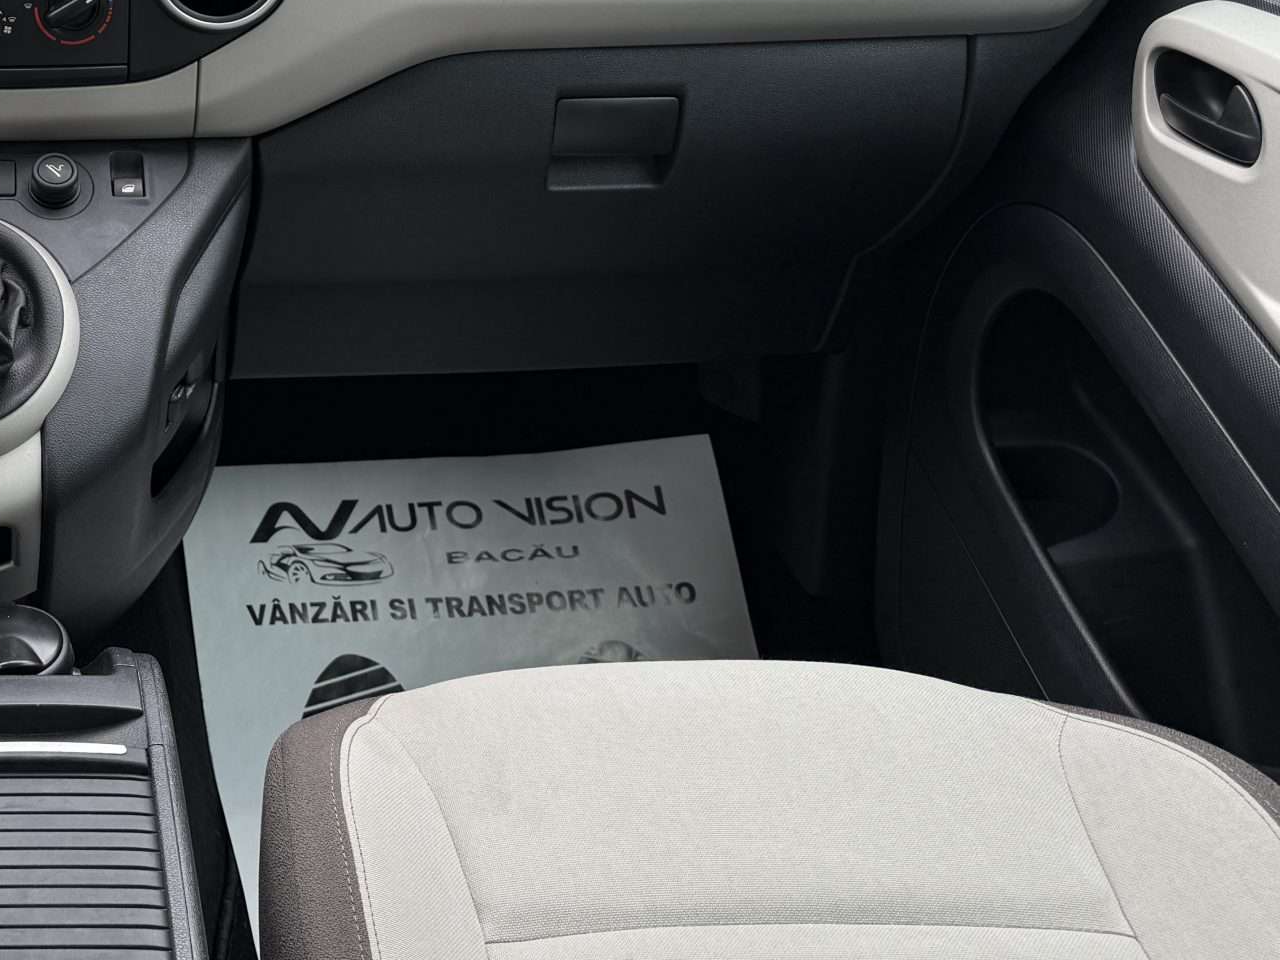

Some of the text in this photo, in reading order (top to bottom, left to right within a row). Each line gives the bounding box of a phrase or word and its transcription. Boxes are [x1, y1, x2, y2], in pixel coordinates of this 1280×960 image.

[348, 500, 484, 535] AUTO
[492, 485, 667, 526] VISION
[446, 544, 581, 565] BACĂU
[246, 595, 380, 626] VÂNZĂRI
[388, 597, 418, 621] SI
[425, 587, 606, 619] TRANSPORT
